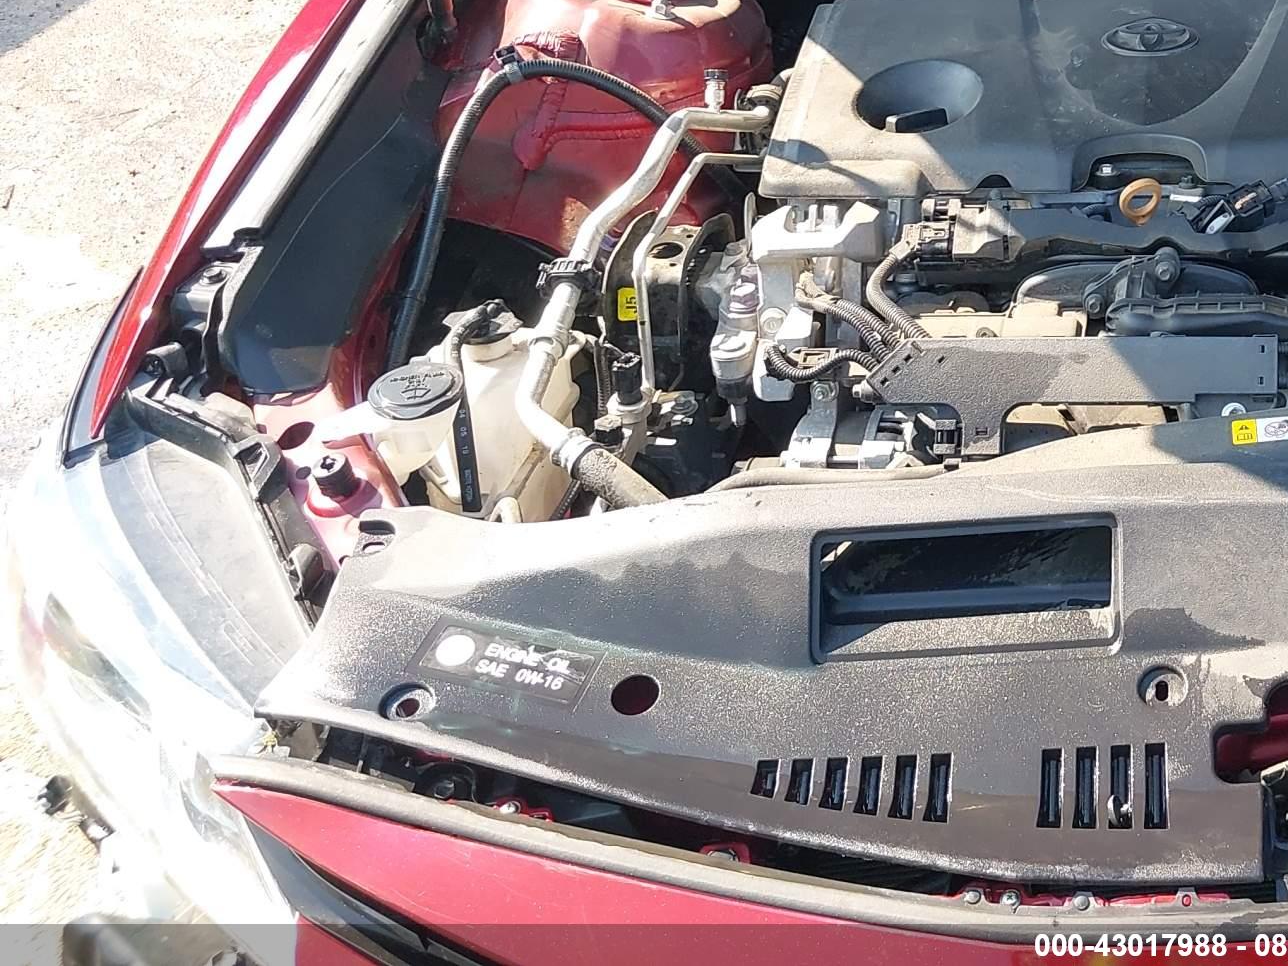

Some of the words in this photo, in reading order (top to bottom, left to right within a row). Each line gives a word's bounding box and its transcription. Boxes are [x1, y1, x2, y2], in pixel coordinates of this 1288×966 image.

[625, 296, 637, 314] J5
[484, 643, 540, 666] ENGINE
[475, 659, 509, 677] SAE
[515, 669, 564, 690] 0W-16
